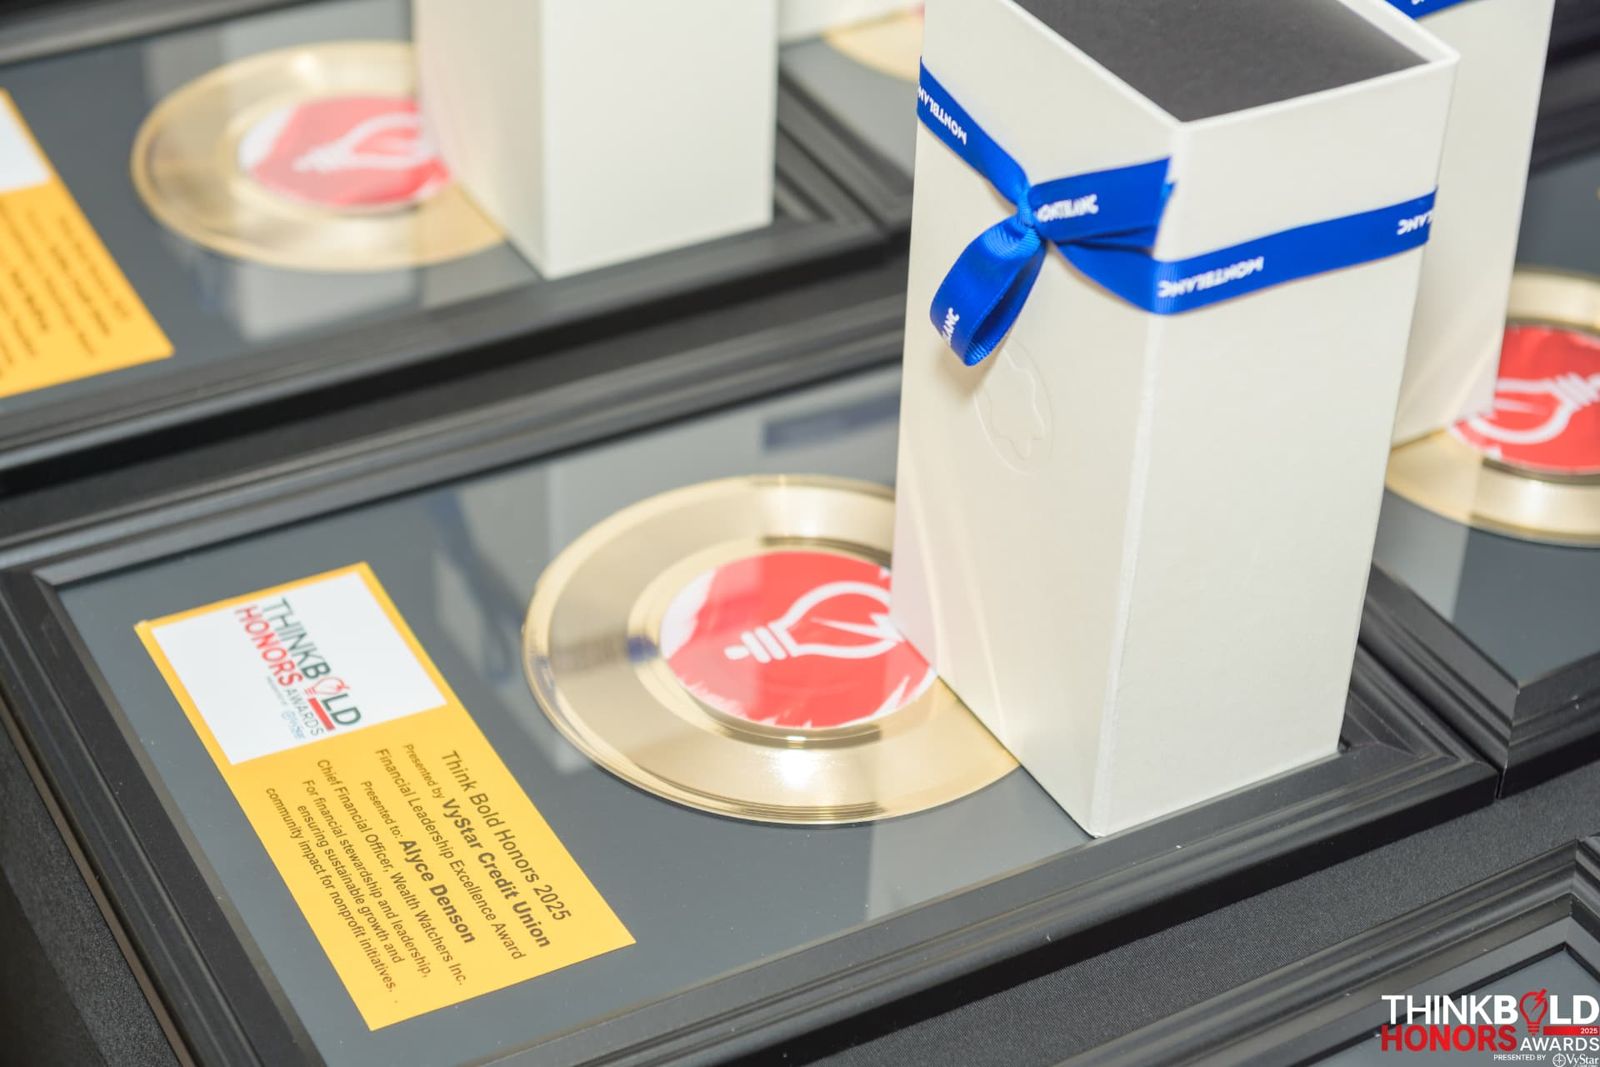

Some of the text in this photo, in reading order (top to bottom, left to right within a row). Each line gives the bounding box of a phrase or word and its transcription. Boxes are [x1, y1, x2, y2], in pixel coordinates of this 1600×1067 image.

[918, 86, 967, 145] MONTBLAN
[1036, 193, 1099, 223] ONTBLANC
[1157, 256, 1264, 298] MONTBLANC
[234, 605, 304, 687] HONORS
[286, 688, 324, 736] AWARDS
[266, 788, 396, 992] community impact for nonprofit initiatives.
[297, 805, 405, 964] ensuring sustainable growth and
[302, 779, 431, 978] For financial stewardship and leadership,
[317, 759, 466, 986] Chief Financial Officer, Wealth Watchers Inc.
[360, 780, 475, 944] Presented to: Alyce Denson
[375, 748, 526, 960] Financial Leadership Excellence Award
[404, 743, 550, 948] Presented by VyStar Credit Union
[441, 750, 572, 921] Think Bold Honors 2025
